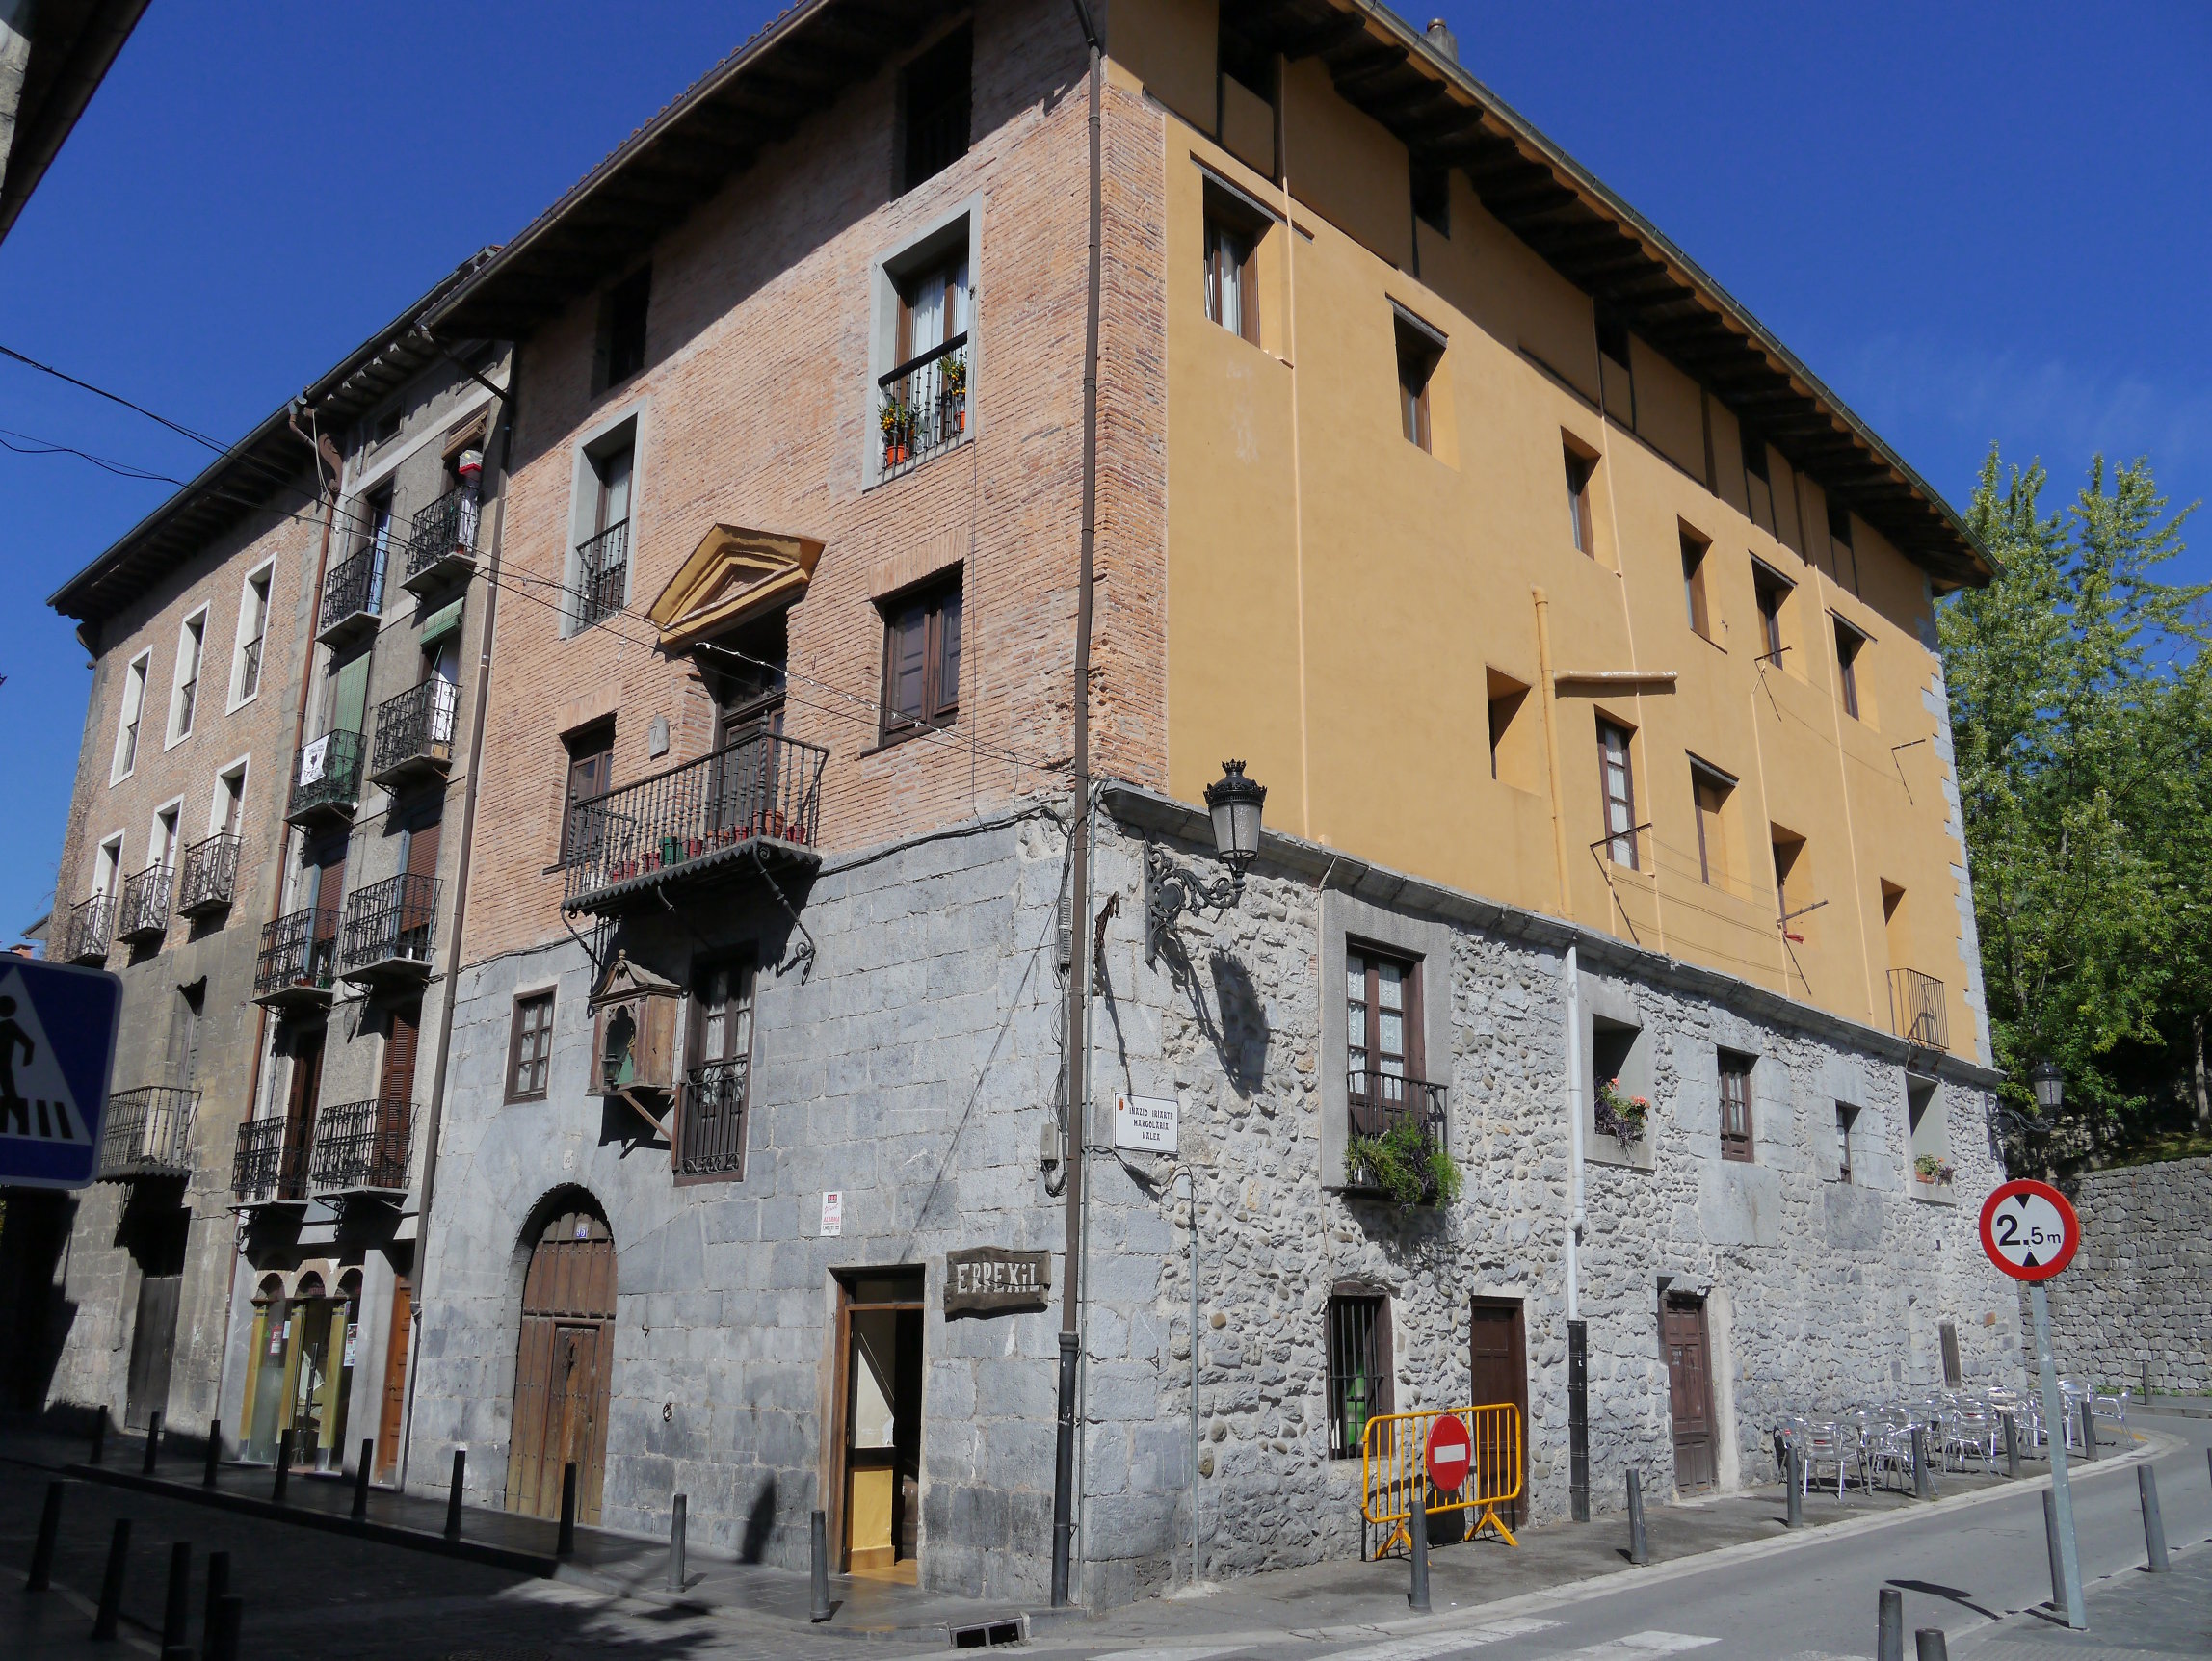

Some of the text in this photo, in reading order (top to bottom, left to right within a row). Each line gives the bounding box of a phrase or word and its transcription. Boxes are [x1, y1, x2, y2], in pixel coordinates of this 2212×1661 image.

[1129, 1106, 1173, 1120] INAZIO IRIARTE
[1133, 1119, 1169, 1130] MARGOLARIA
